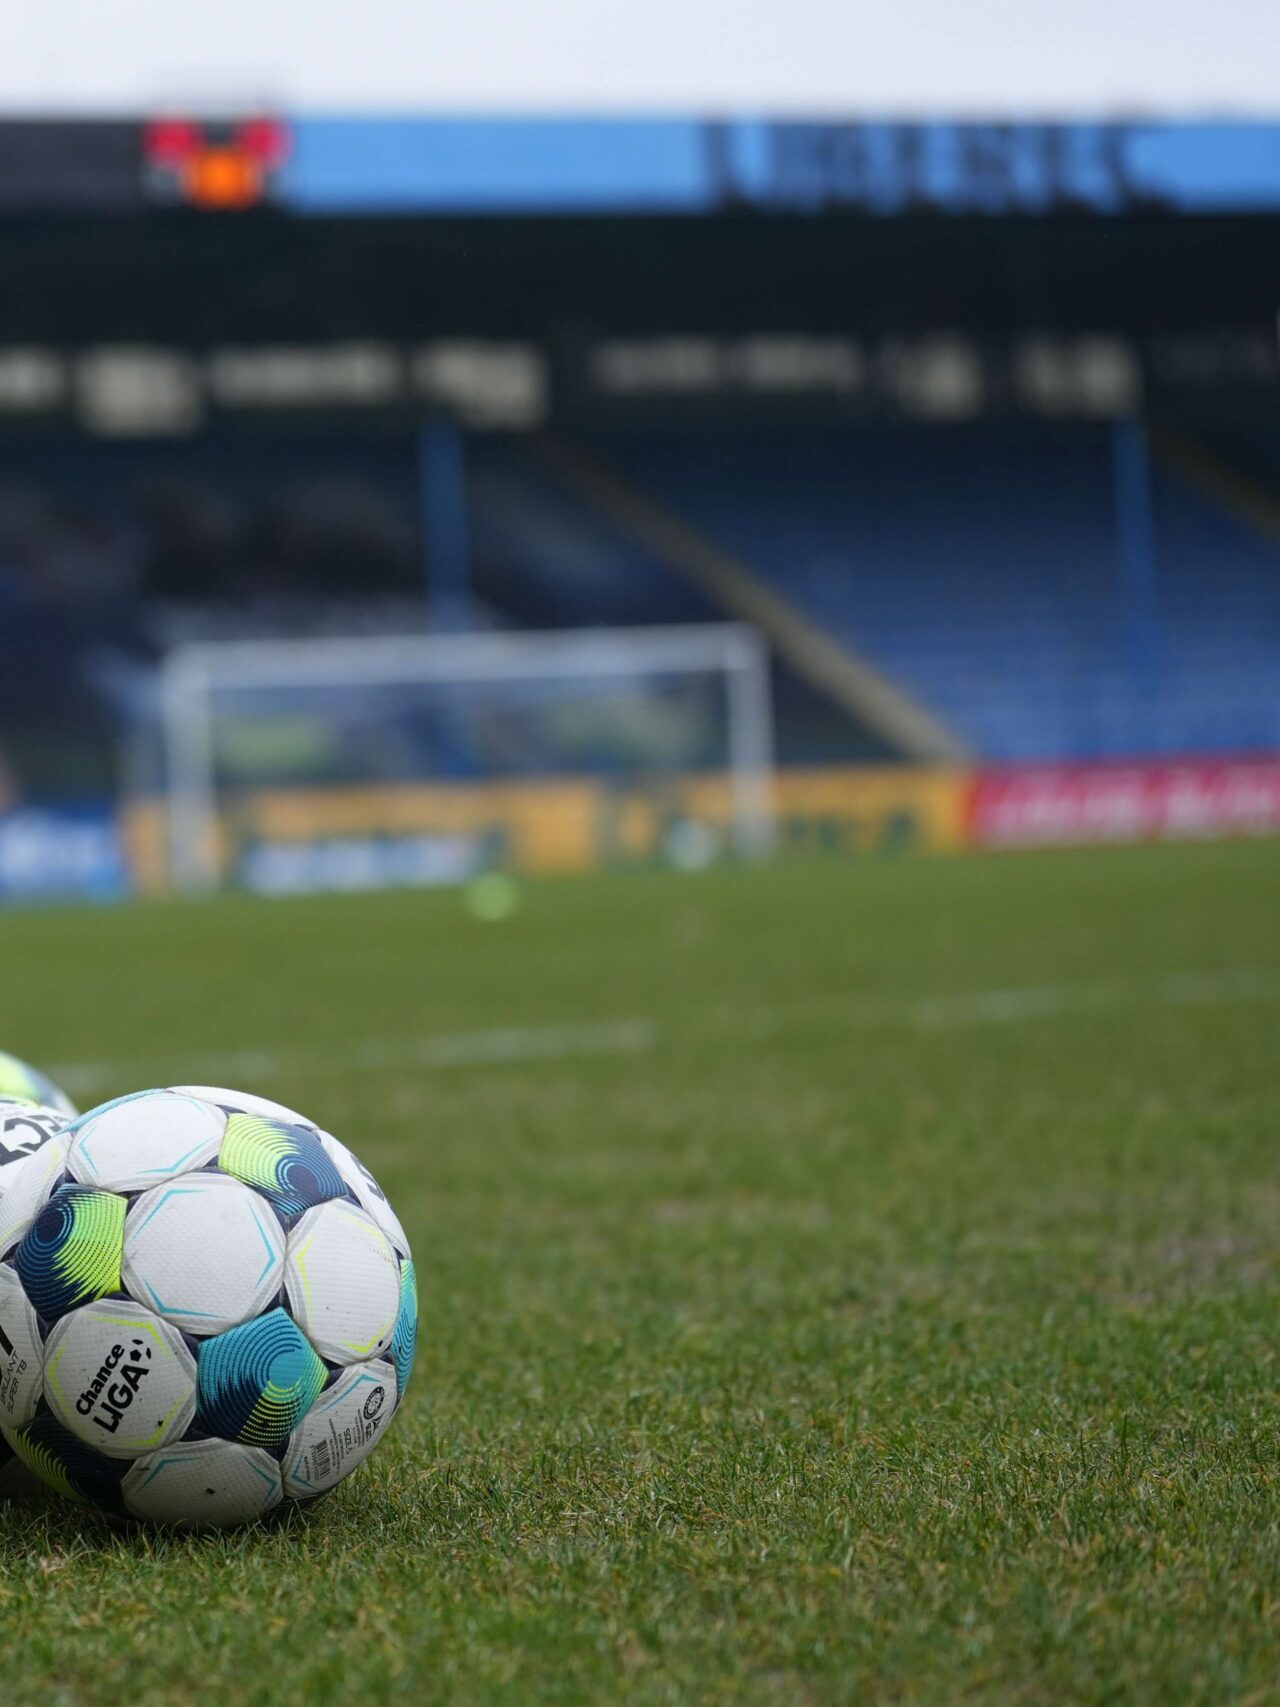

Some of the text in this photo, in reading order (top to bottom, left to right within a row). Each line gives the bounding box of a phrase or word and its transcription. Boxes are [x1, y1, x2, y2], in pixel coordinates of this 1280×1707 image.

[16, 1359, 27, 1376] TB
[76, 1344, 125, 1415] Chance
[93, 1364, 150, 1433] LIGA
